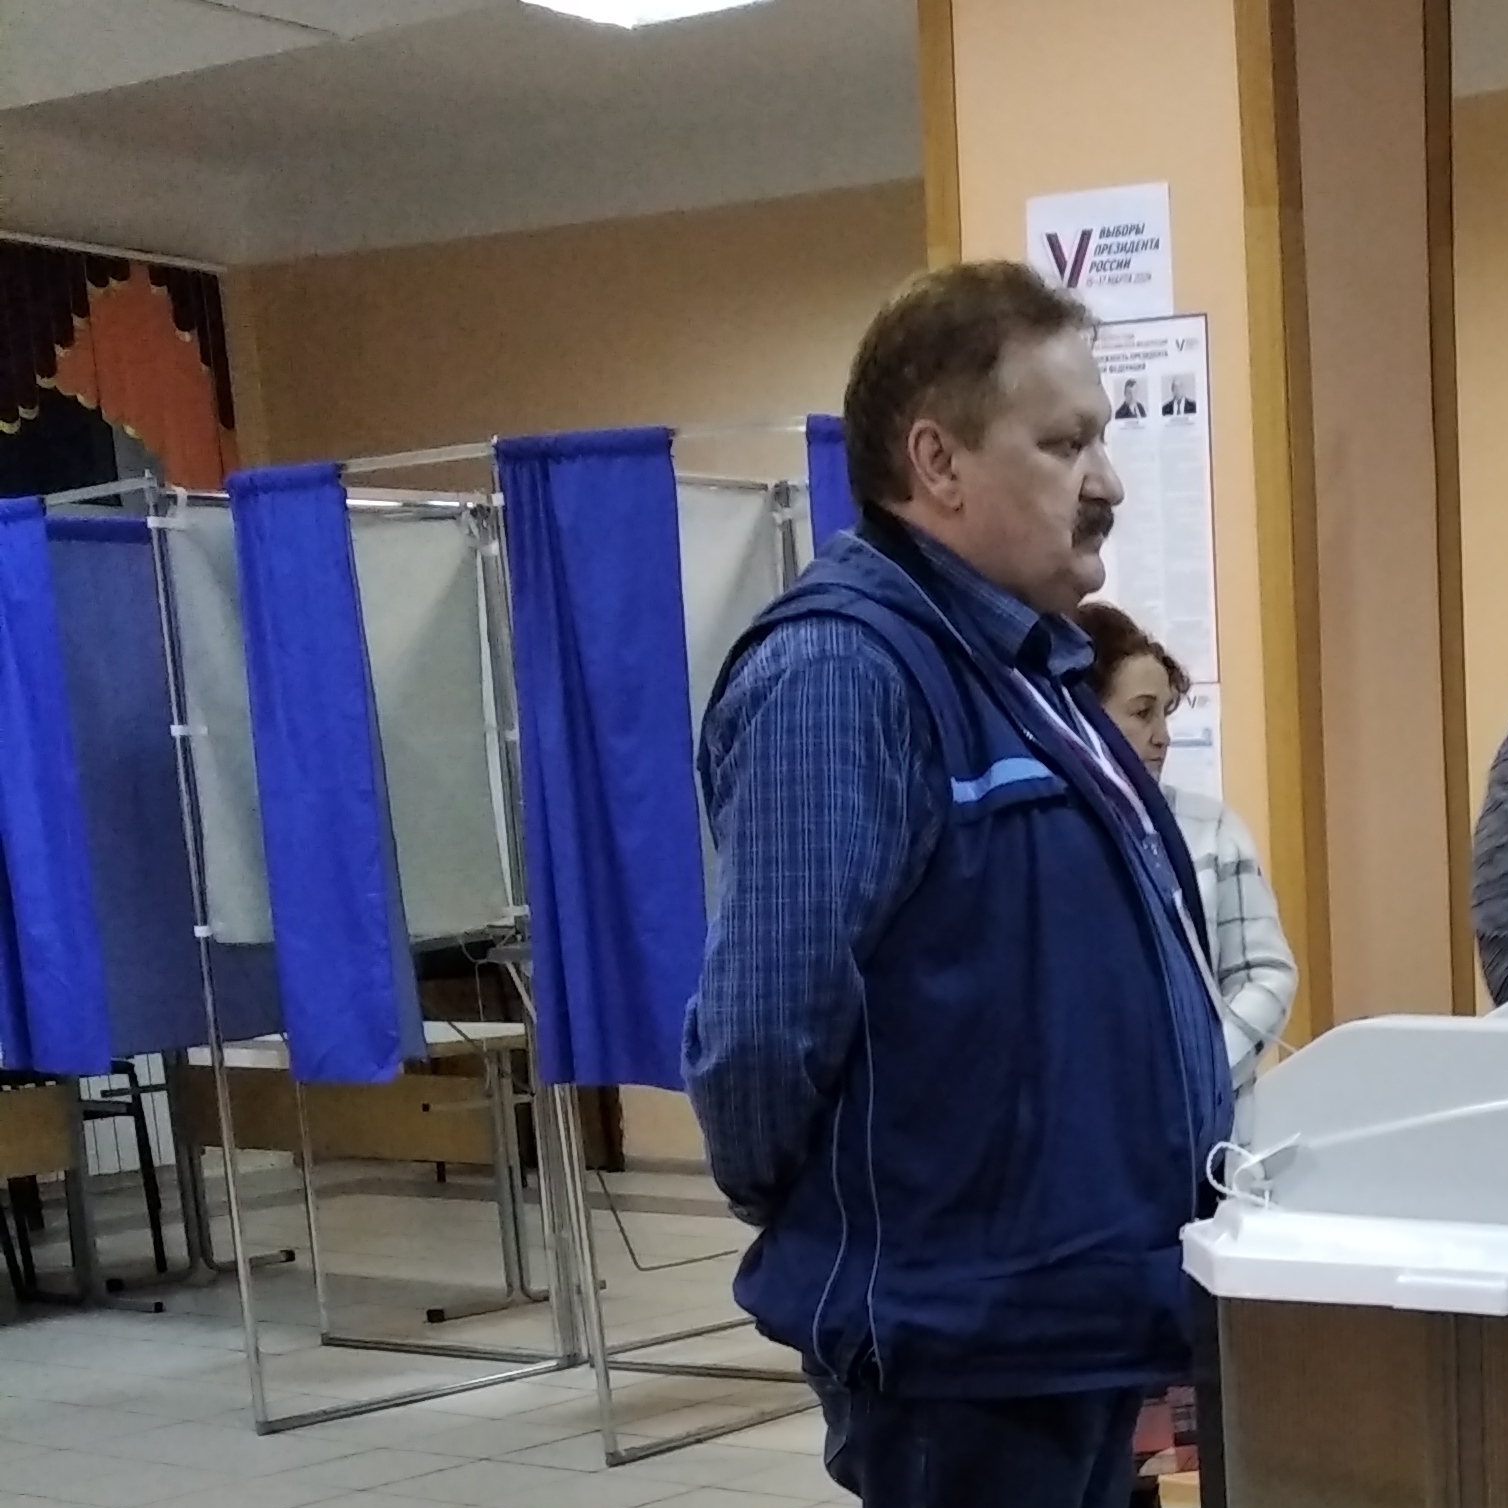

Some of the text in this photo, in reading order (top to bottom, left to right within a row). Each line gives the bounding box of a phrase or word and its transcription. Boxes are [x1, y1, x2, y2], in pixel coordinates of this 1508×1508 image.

[1098, 222, 1145, 239] ВЫБОРЫ
[1093, 238, 1160, 257] ПРЕЗИДЕНТА
[1088, 258, 1132, 273] РОССИИ
